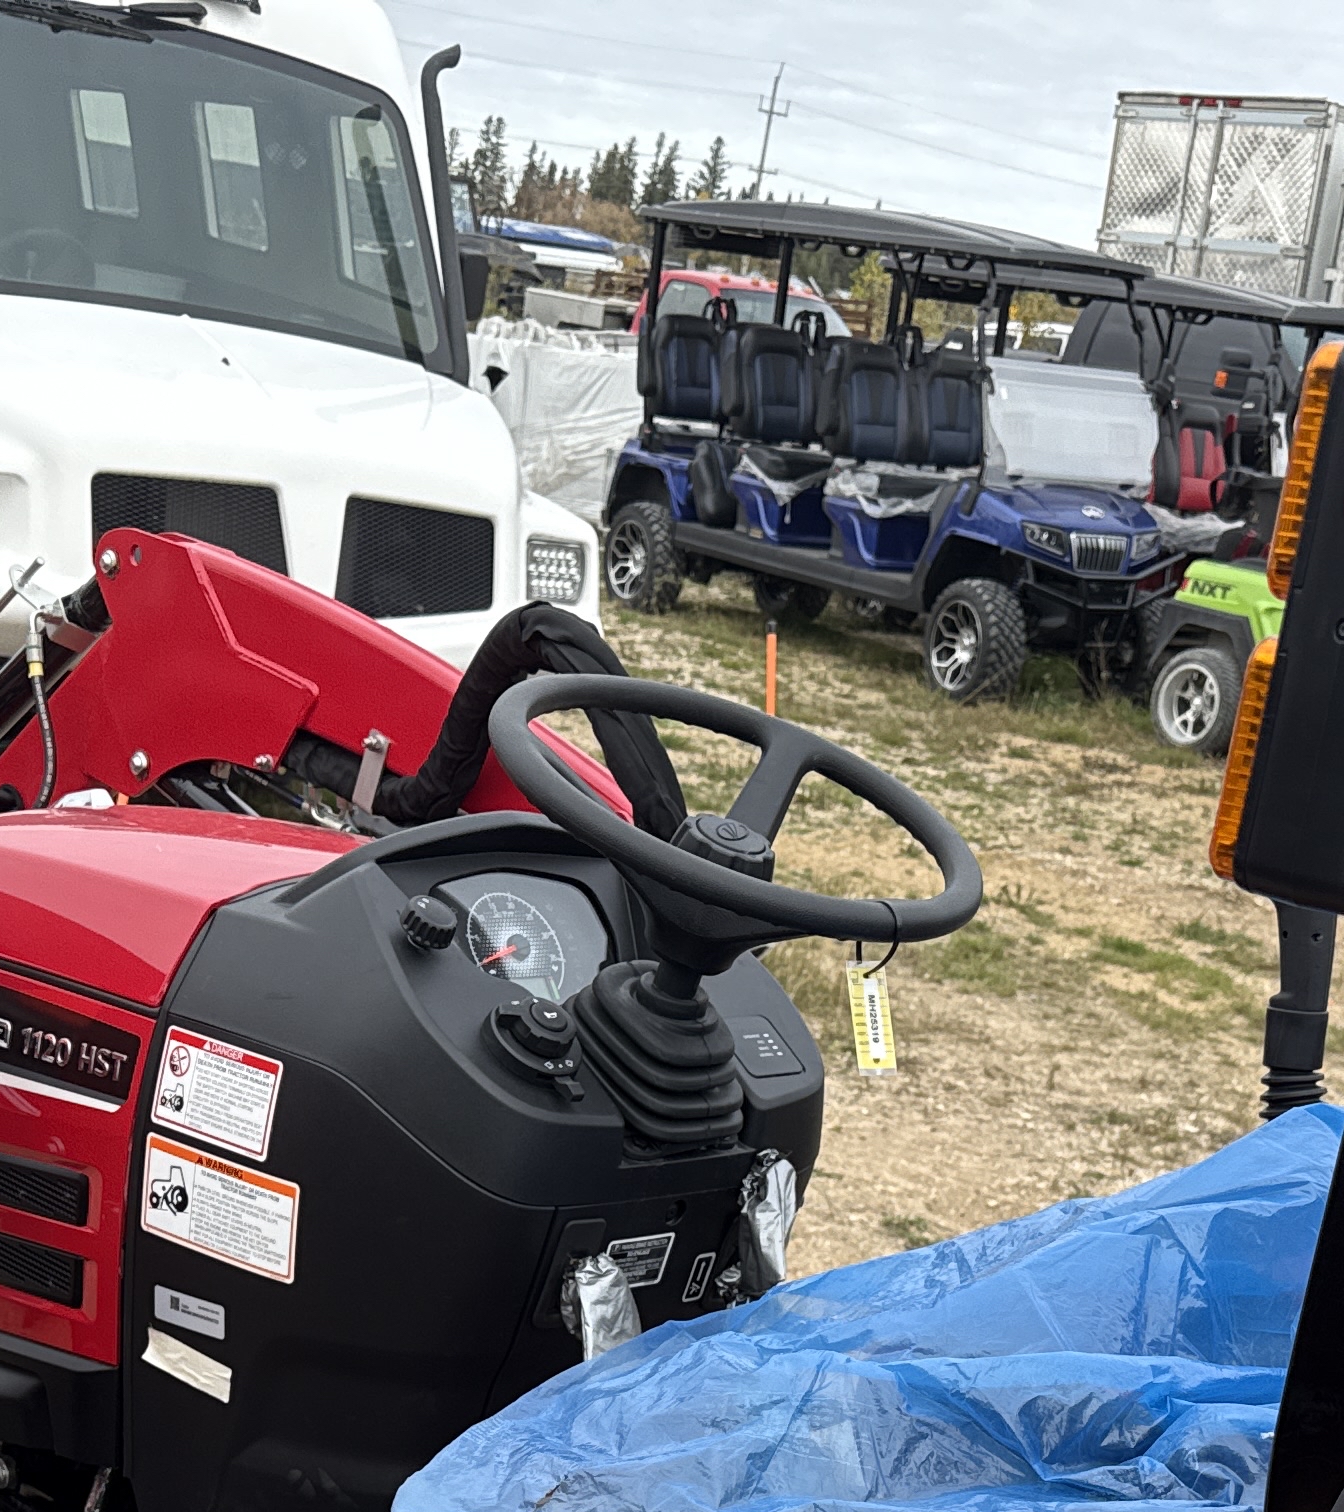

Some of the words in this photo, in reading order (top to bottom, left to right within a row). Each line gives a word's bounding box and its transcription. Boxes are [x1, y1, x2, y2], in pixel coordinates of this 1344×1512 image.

[1190, 580, 1233, 600] NXT
[21, 1027, 72, 1067] 1120
[77, 1042, 128, 1081] HST
[210, 1042, 244, 1061] DANGER
